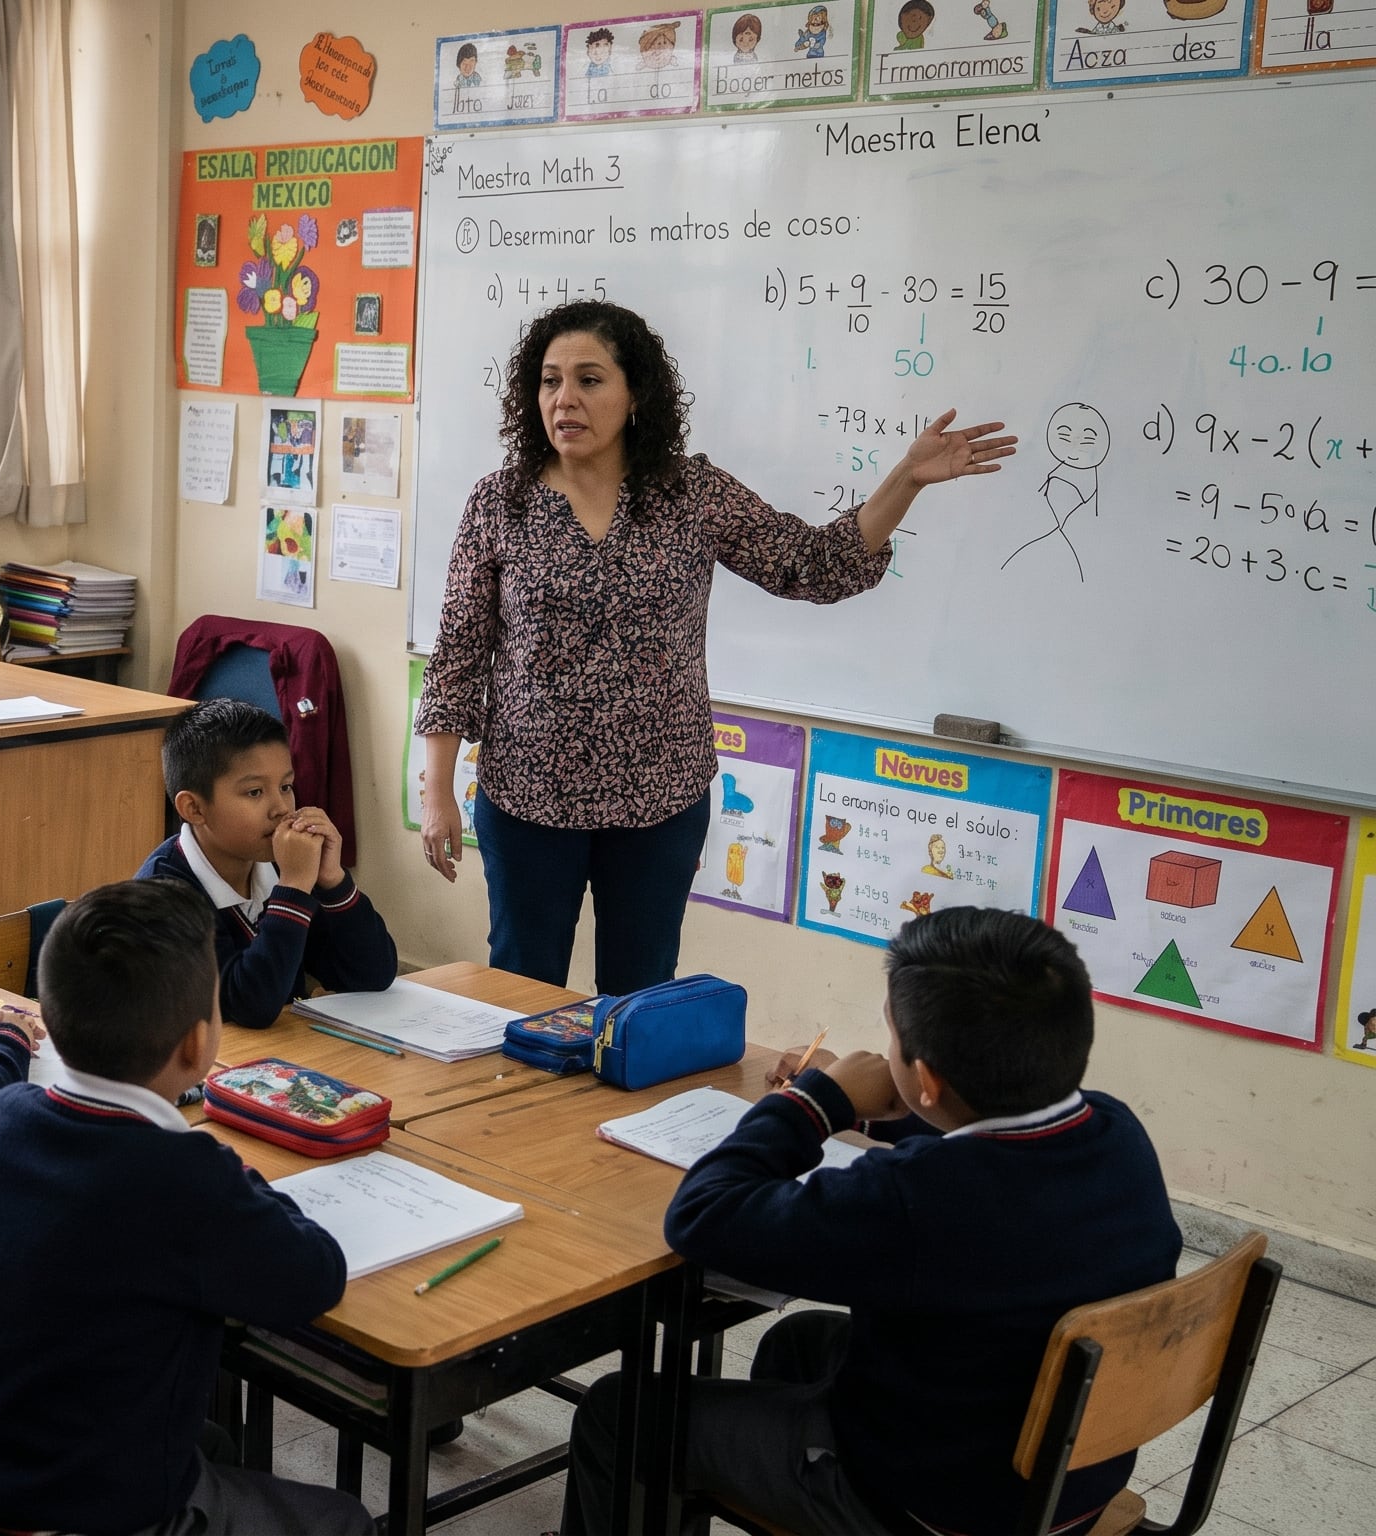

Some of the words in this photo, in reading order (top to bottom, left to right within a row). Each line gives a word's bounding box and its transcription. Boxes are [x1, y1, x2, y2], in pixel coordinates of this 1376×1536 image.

[1172, 33, 1216, 62] des
[785, 62, 844, 89] metos
[197, 152, 255, 181] ESALA
[457, 161, 532, 192] Maestra
[542, 157, 595, 185] Math
[605, 155, 622, 183] 3
[256, 180, 331, 209] MEXICO
[489, 218, 596, 247] Deserminar
[609, 214, 637, 244] los
[650, 211, 731, 242] matros
[743, 208, 772, 239] de
[487, 272, 504, 309] a)
[518, 277, 530, 305] 4
[593, 277, 607, 305] 5
[764, 266, 788, 312] b)
[797, 274, 817, 305] 5
[903, 275, 938, 304] 30
[1145, 258, 1181, 310] c)
[1203, 264, 1270, 305] 30
[1312, 259, 1340, 302] 9
[893, 348, 935, 378] 50
[1142, 403, 1175, 456] d)
[1189, 535, 1232, 569] 20
[819, 782, 836, 804] La
[906, 808, 938, 825] que
[945, 811, 959, 829] el
[1128, 791, 1262, 839] Primares
